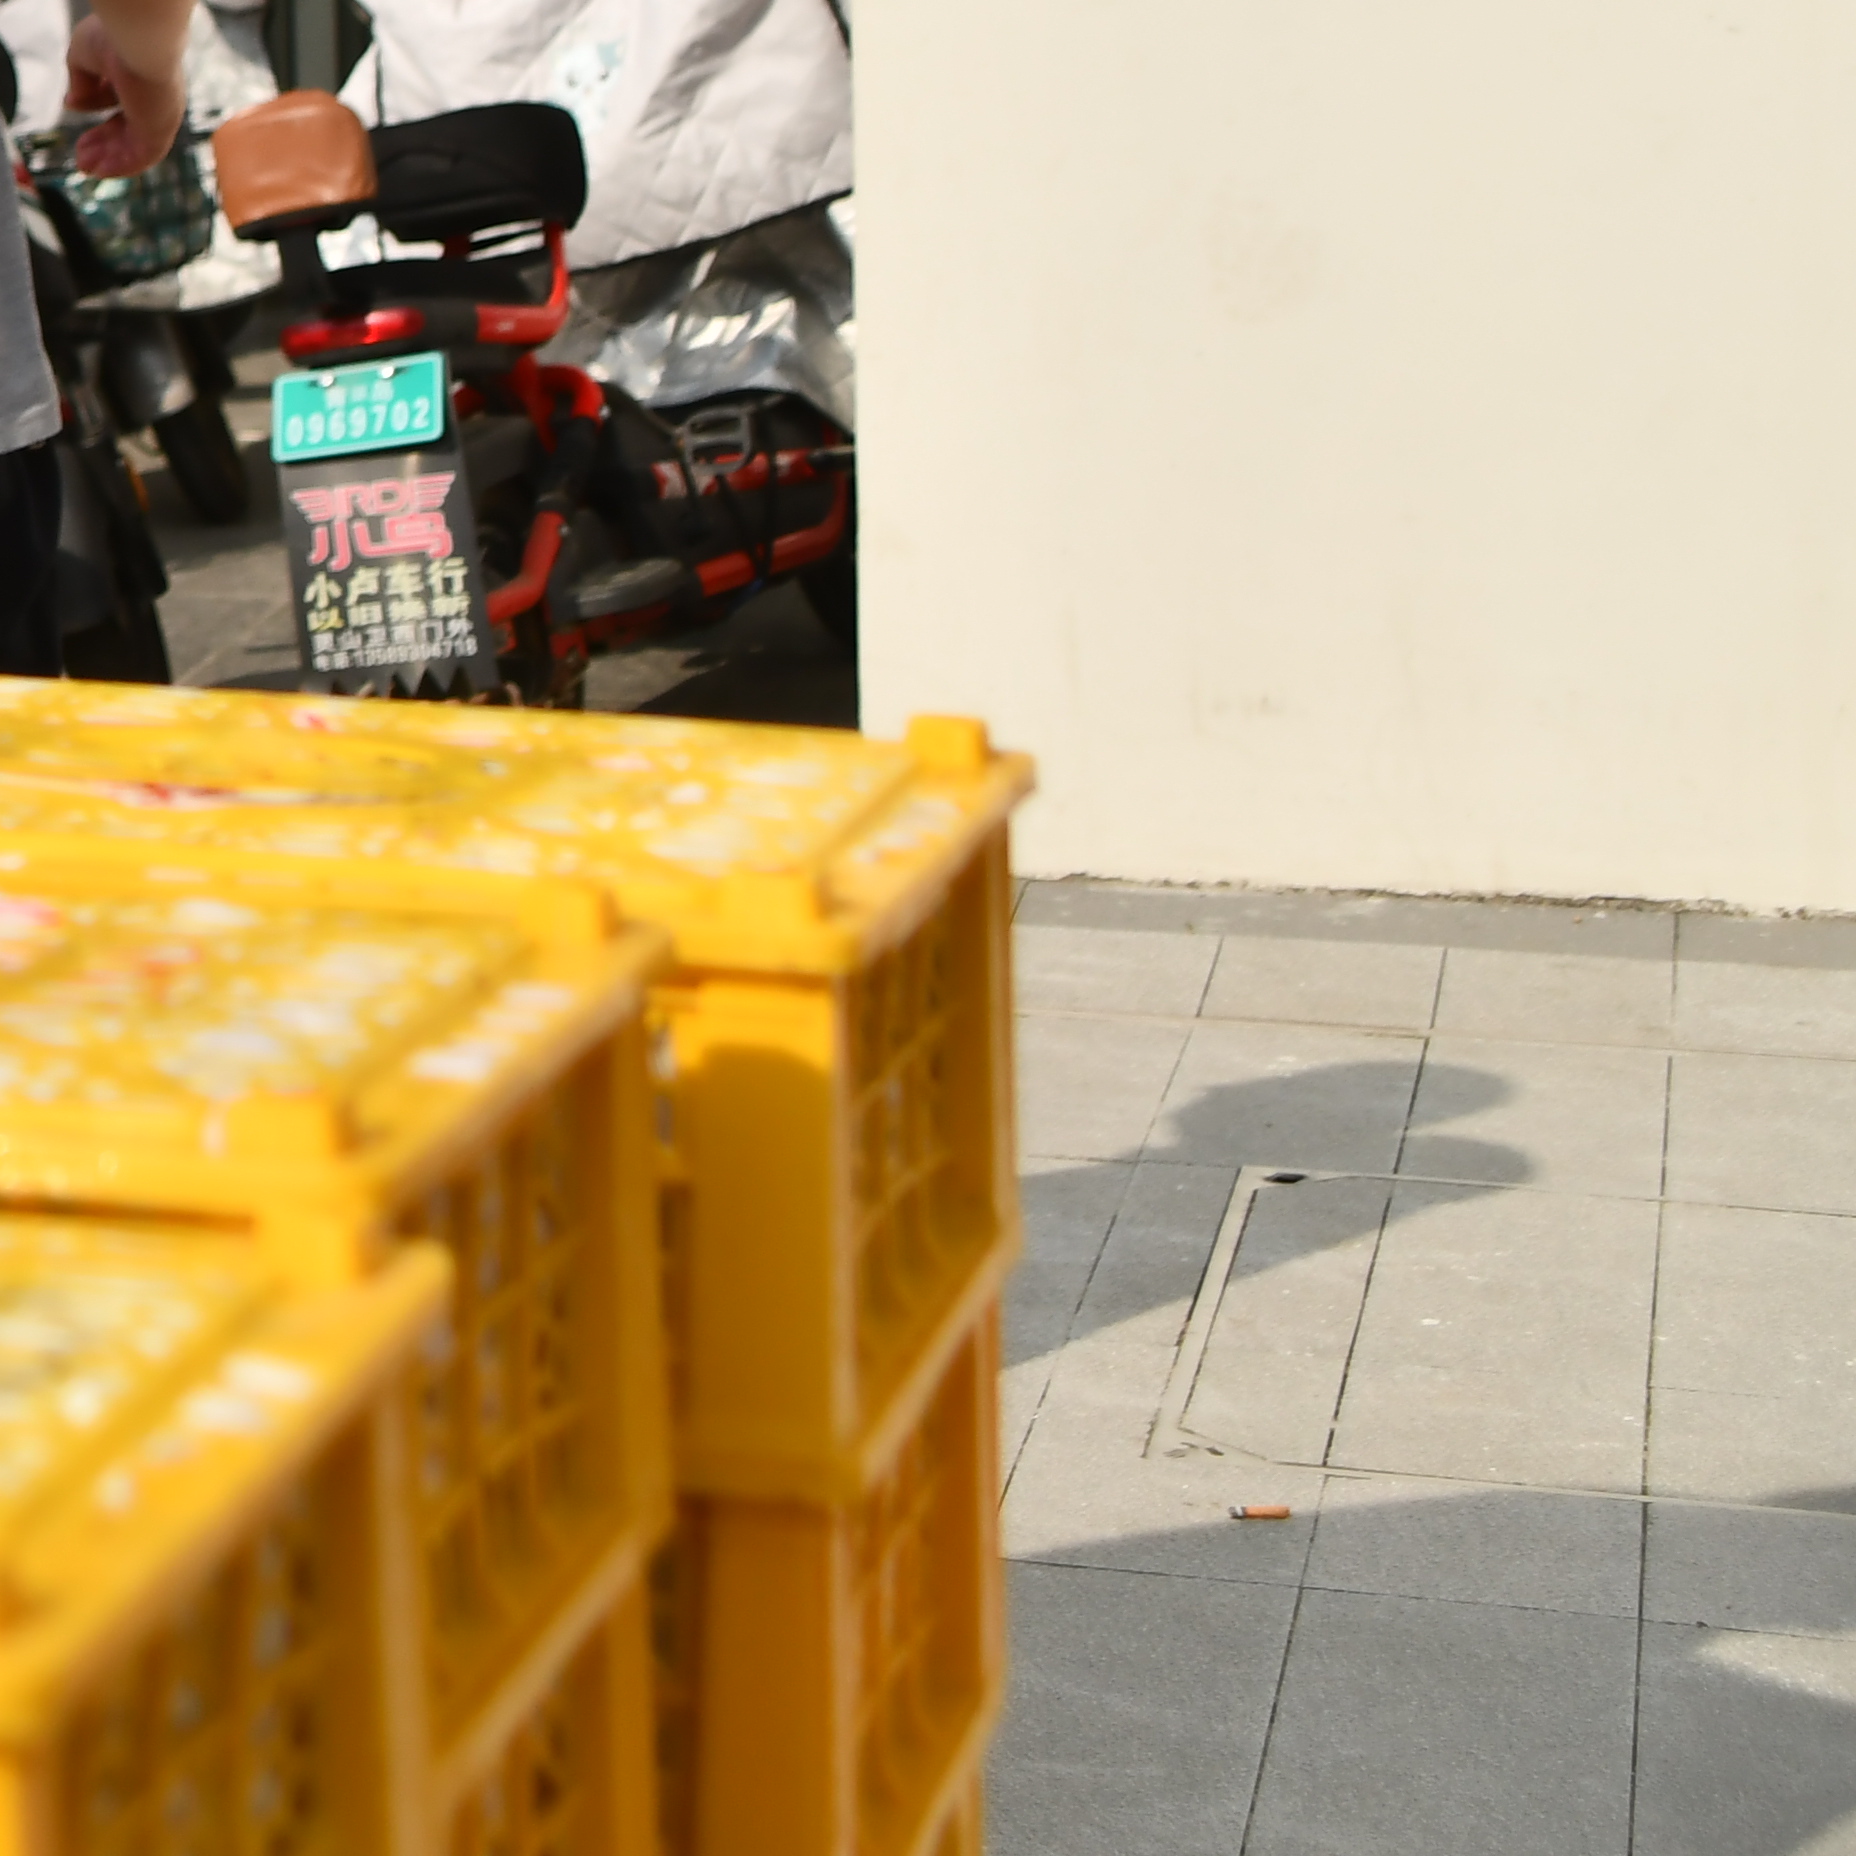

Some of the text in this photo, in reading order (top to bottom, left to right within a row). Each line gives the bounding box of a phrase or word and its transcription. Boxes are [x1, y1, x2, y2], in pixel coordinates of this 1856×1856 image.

[284, 396, 431, 448] 0969702
[307, 510, 454, 573] 小鸟
[303, 556, 469, 610] 小卢车行
